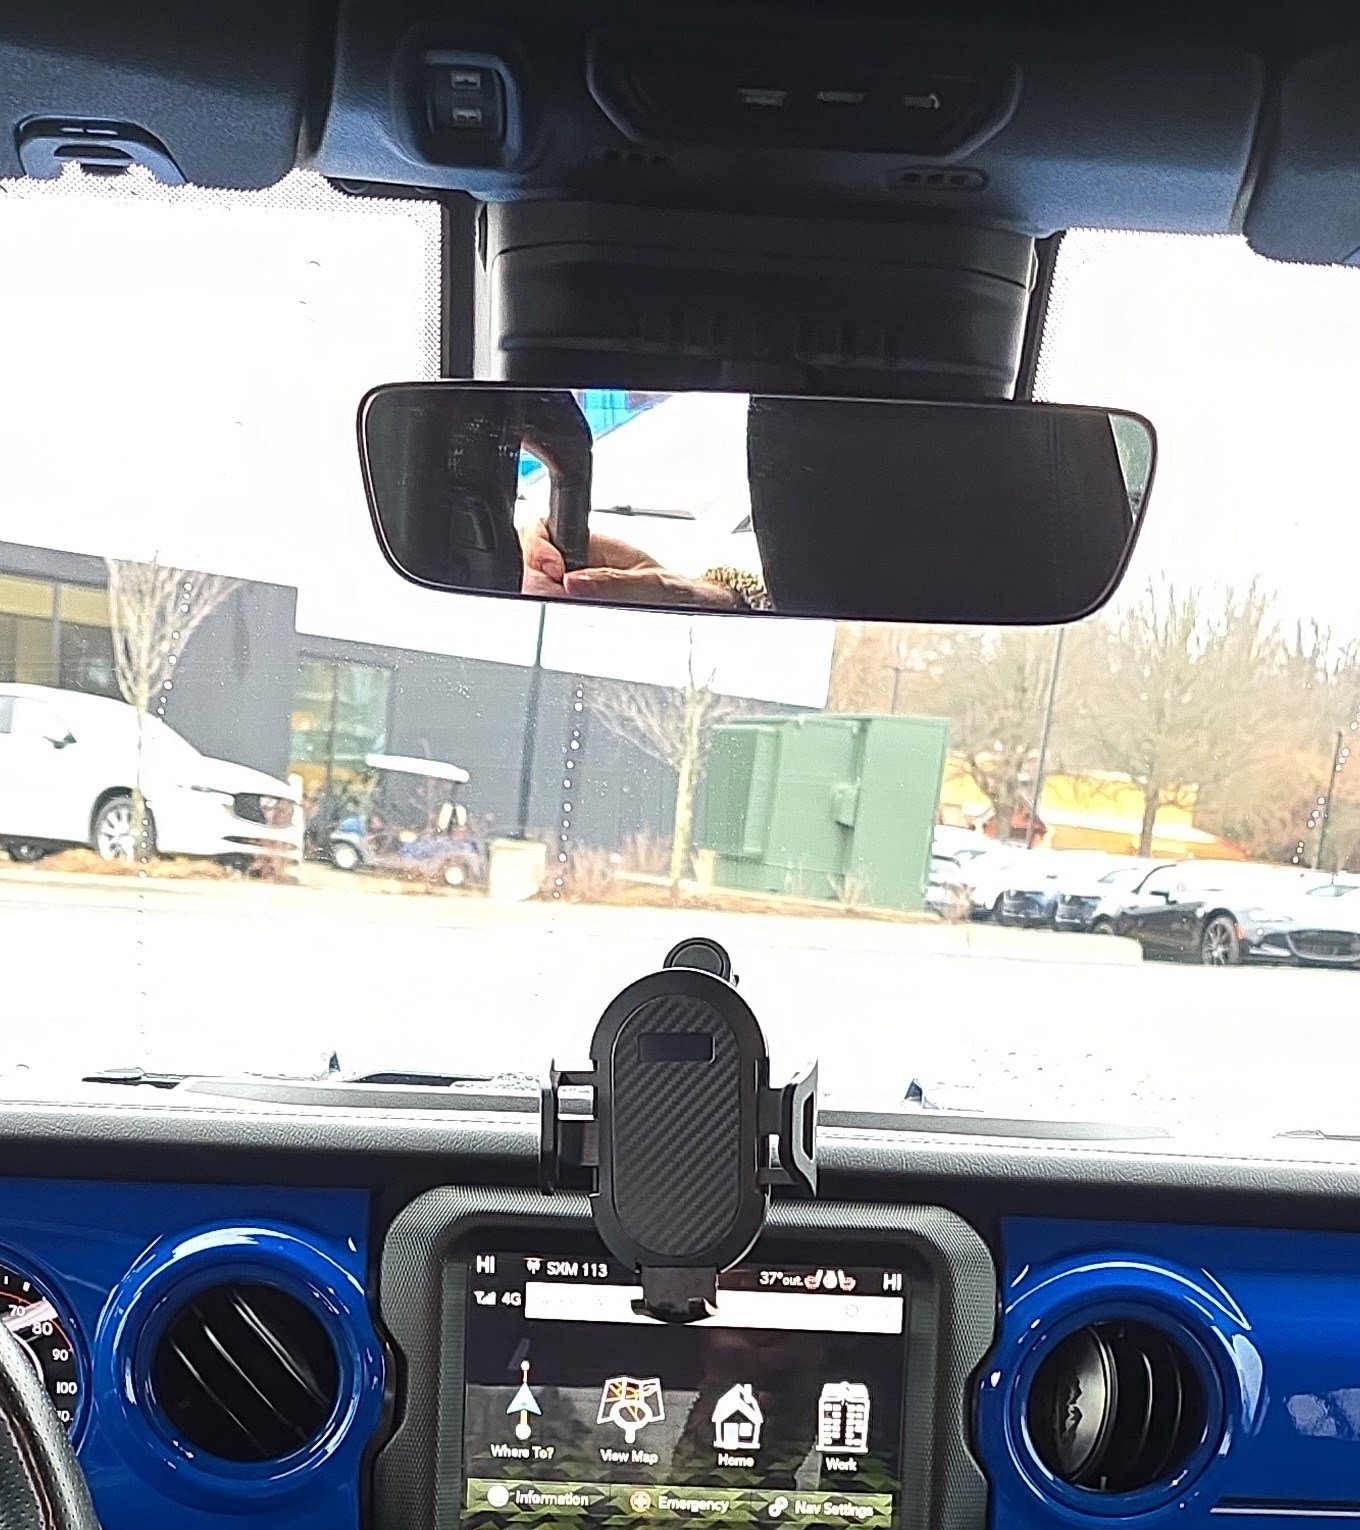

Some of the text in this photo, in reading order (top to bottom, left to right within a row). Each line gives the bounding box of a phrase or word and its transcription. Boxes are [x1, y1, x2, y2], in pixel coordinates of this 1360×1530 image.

[476, 1255, 608, 1278] HI SXM 113
[883, 1273, 902, 1291] HI
[501, 1291, 522, 1306] 4G
[9, 1305, 26, 1317] 70
[31, 1322, 53, 1336] 80
[52, 1349, 68, 1362] 90
[56, 1381, 77, 1395] 100
[490, 1443, 555, 1460] Where To?
[599, 1448, 659, 1465] View Map
[717, 1453, 754, 1468] Home
[825, 1456, 858, 1472] Work
[515, 1490, 590, 1507] Information
[658, 1495, 730, 1515] Emergency
[794, 1499, 874, 1518] Nav Settings
